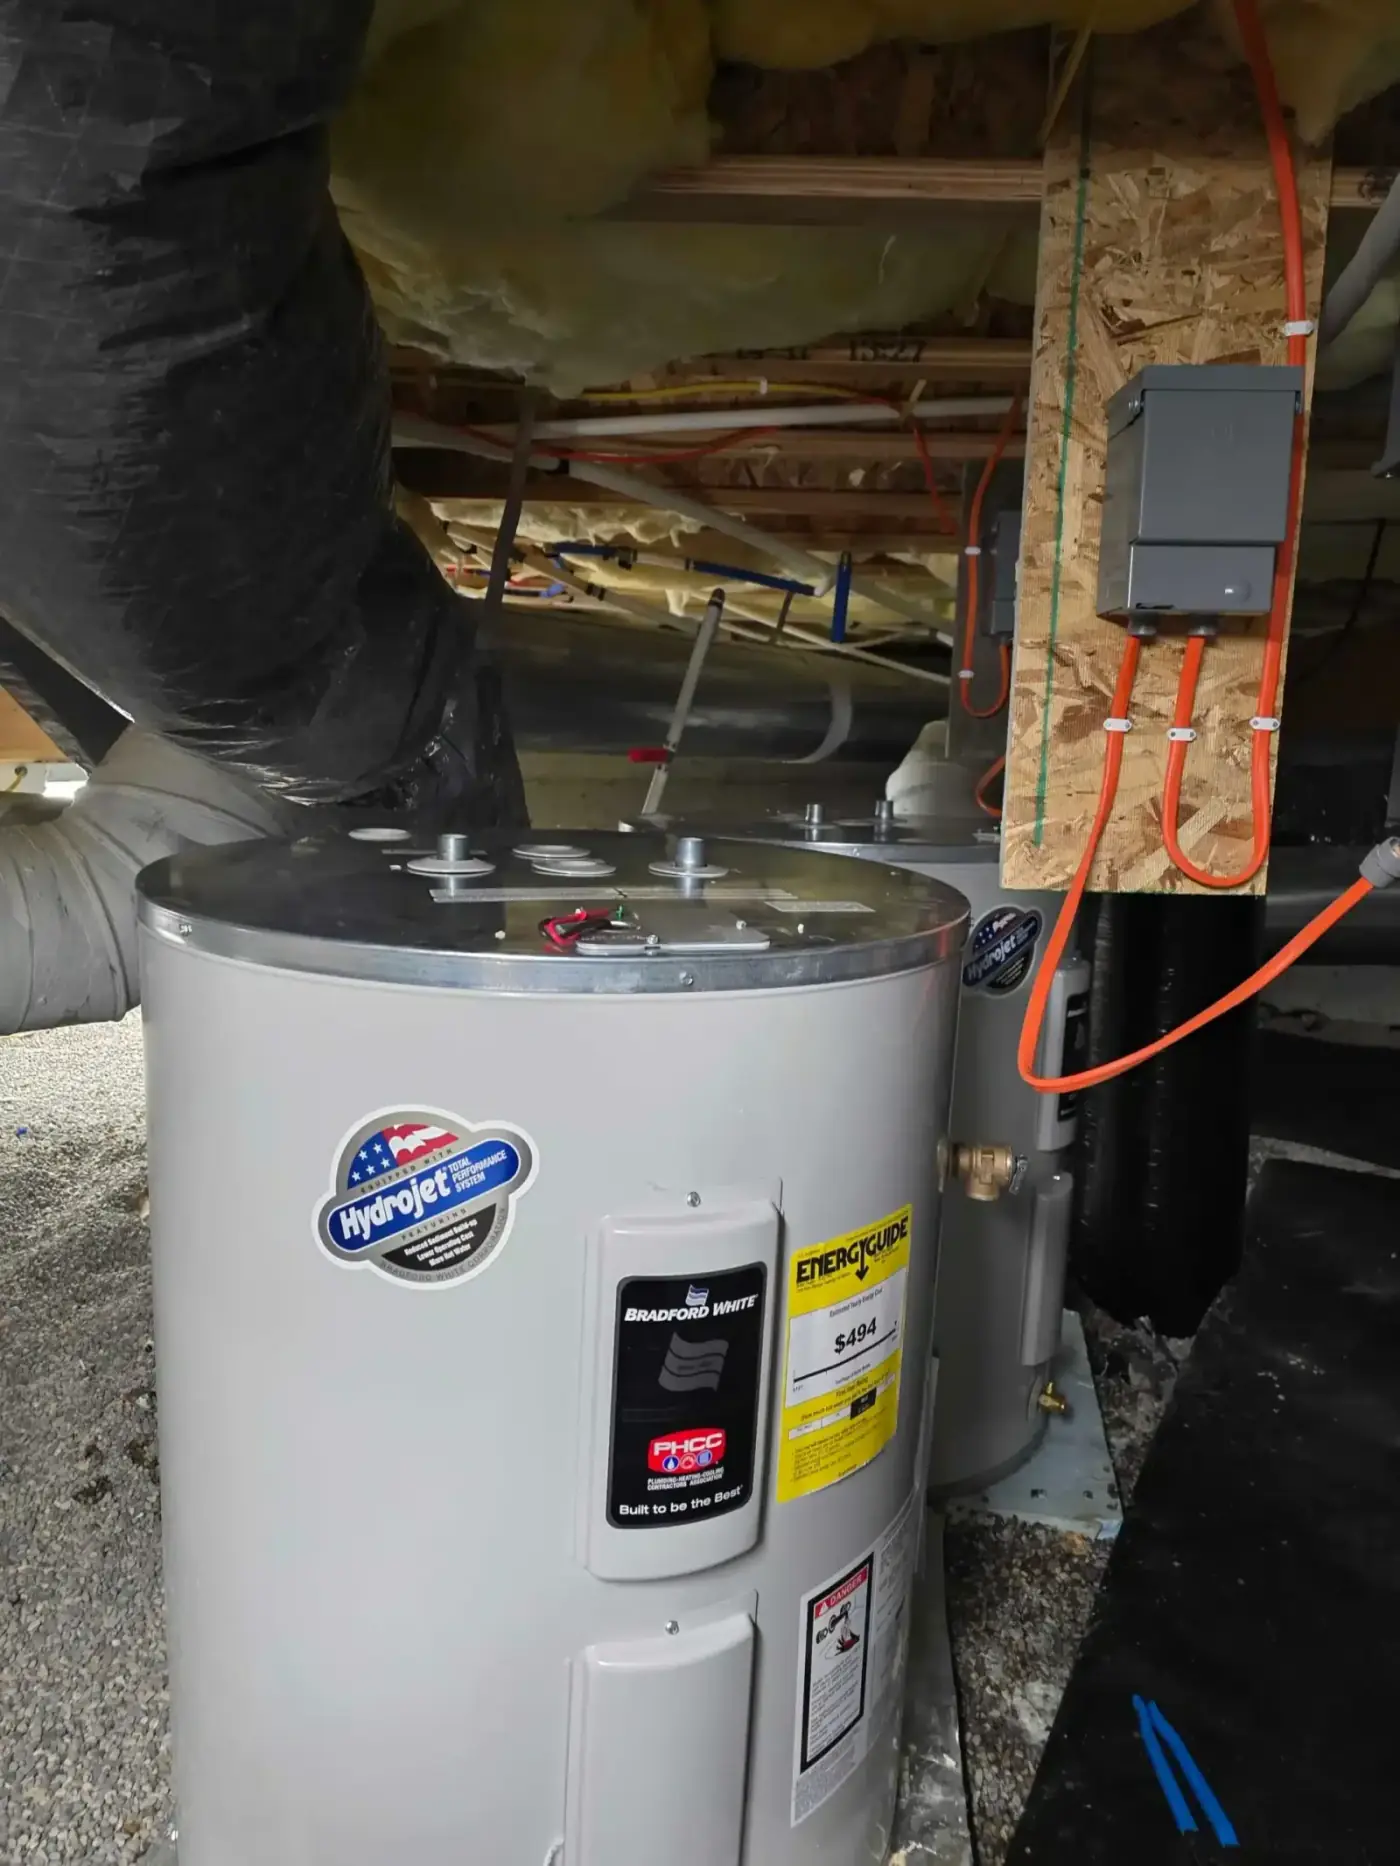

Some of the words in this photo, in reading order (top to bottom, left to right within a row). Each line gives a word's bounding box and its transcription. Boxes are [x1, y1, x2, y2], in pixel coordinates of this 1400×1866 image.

[967, 934, 1017, 981] Hydrojet
[448, 1156, 472, 1174] TOTAL
[452, 1150, 507, 1183] PERFORMANCE
[455, 1172, 486, 1193] SYSTEM
[339, 1168, 451, 1241] Hydrojet
[797, 1216, 908, 1284] ENERGYGUIDE
[624, 1306, 710, 1322] BRADFORD
[713, 1294, 756, 1317] WHITE
[834, 1316, 877, 1355] $494
[653, 1432, 723, 1456] PHCC
[619, 1504, 649, 1515] Built
[652, 1504, 667, 1514] to
[670, 1501, 687, 1513] be
[691, 1497, 711, 1509] the
[714, 1486, 741, 1503] Best
[829, 1574, 862, 1607] DANGER
